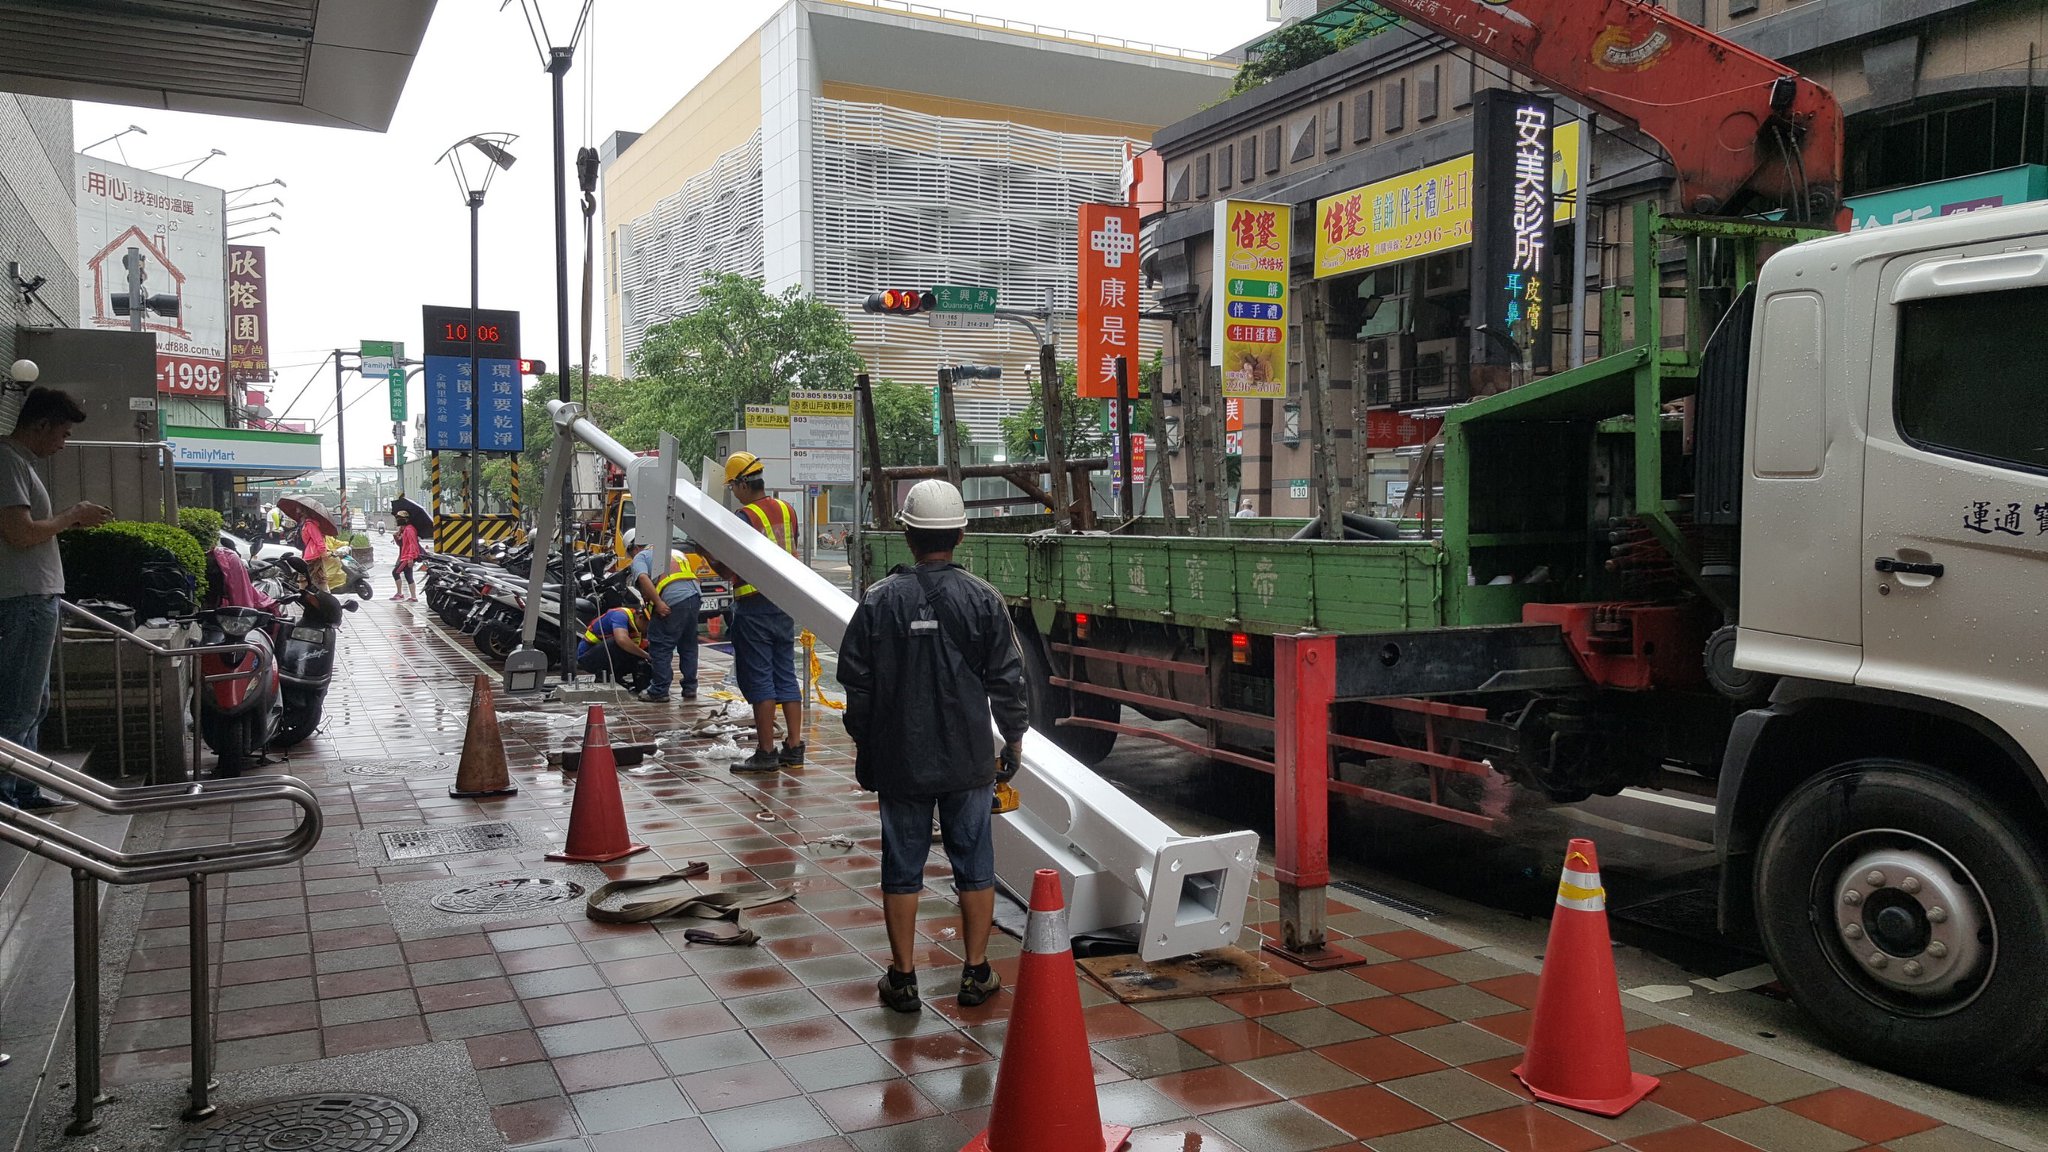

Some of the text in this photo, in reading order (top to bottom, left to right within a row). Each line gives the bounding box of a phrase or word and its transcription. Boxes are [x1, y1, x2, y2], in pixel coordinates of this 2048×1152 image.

[1513, 106, 1546, 272] 安美診所
[230, 250, 261, 342] 欣榕園
[940, 288, 989, 302] 全興路
[1234, 280, 1278, 297] 喜餅
[942, 301, 972, 310] Quanxing
[1234, 302, 1279, 319] 伴手禮
[445, 323, 499, 341] 10 06
[1100, 277, 1126, 383] 康是美
[1232, 326, 1277, 342] 生日蛋糕
[492, 364, 513, 446] 環境要乾淨
[181, 447, 235, 462] FamilyMart
[1293, 487, 1306, 497] 130
